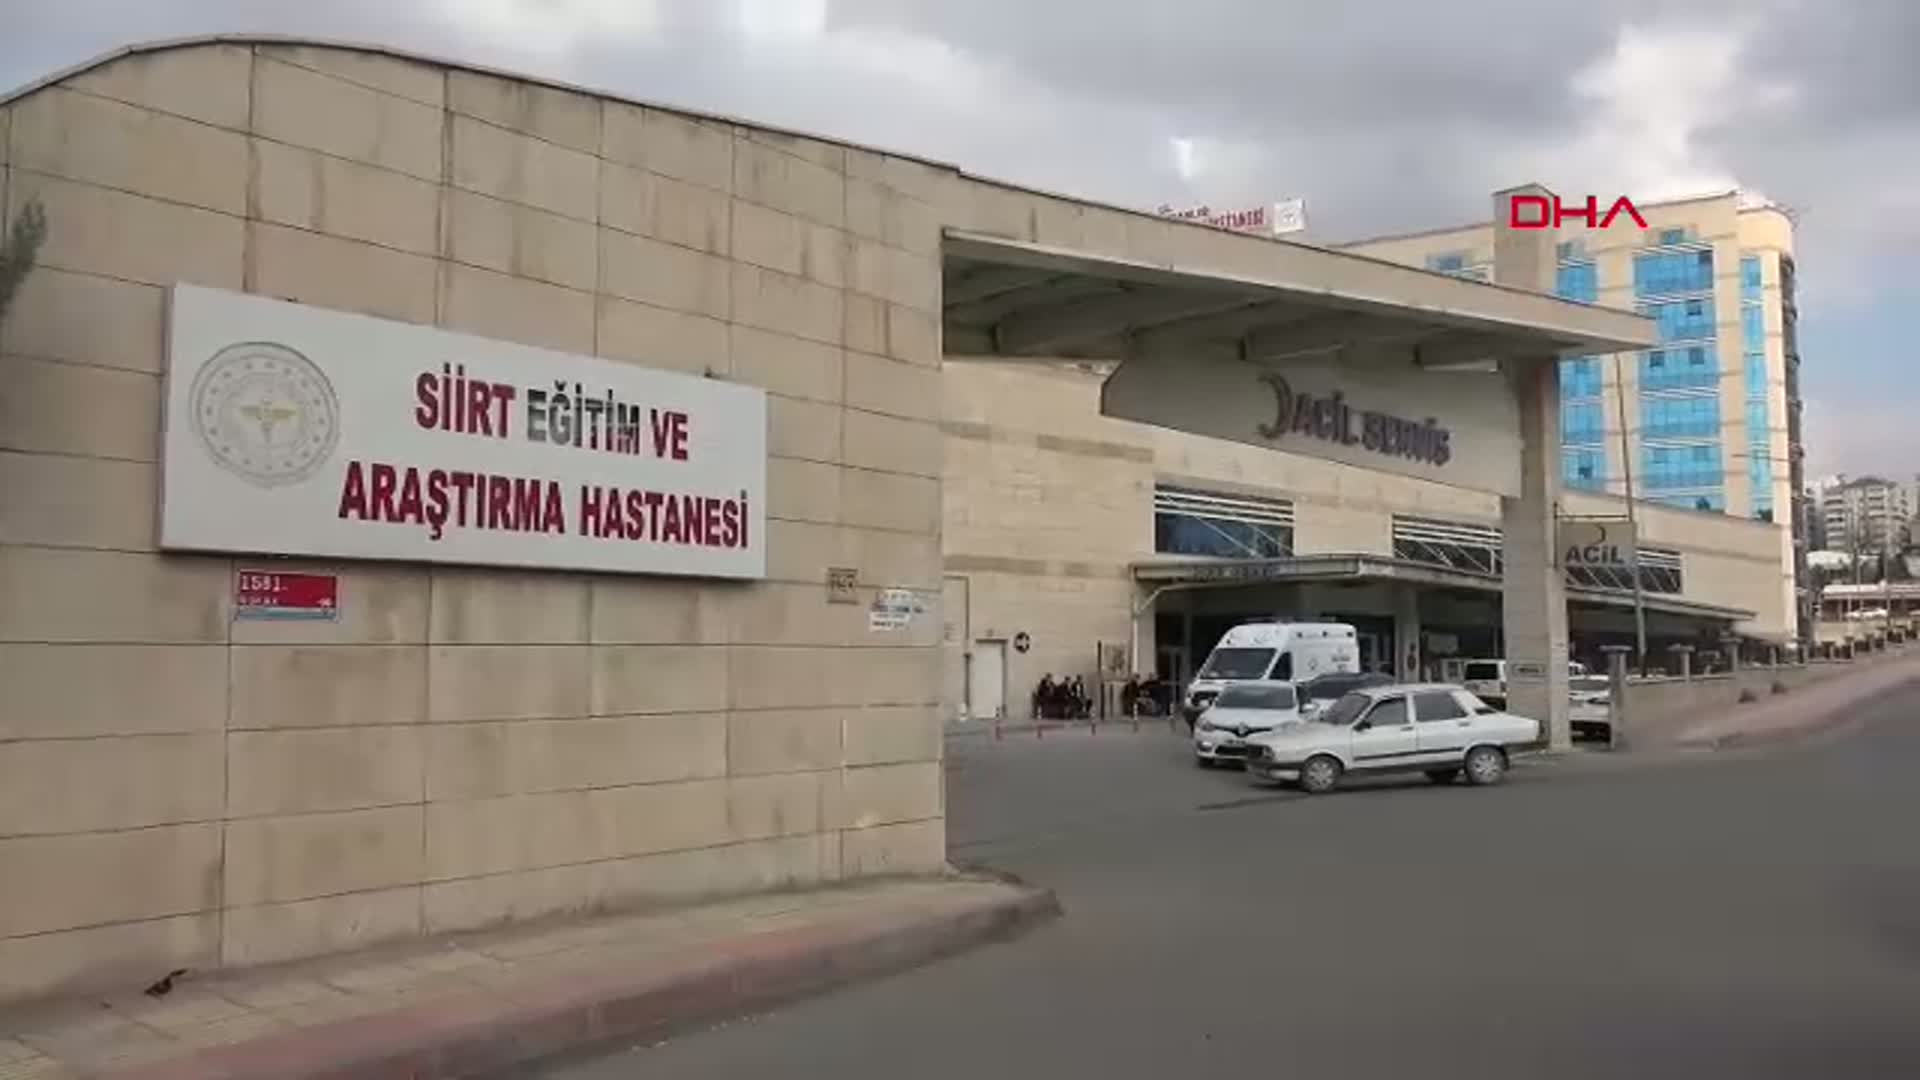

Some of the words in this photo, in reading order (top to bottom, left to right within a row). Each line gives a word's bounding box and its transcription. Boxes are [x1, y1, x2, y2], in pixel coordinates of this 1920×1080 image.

[416, 362, 516, 437] SİİRT
[527, 382, 640, 454] EĞİTİM
[651, 409, 689, 459] VE
[338, 462, 565, 540] ARAŞTIRMA
[580, 488, 748, 548] HASTANESİ
